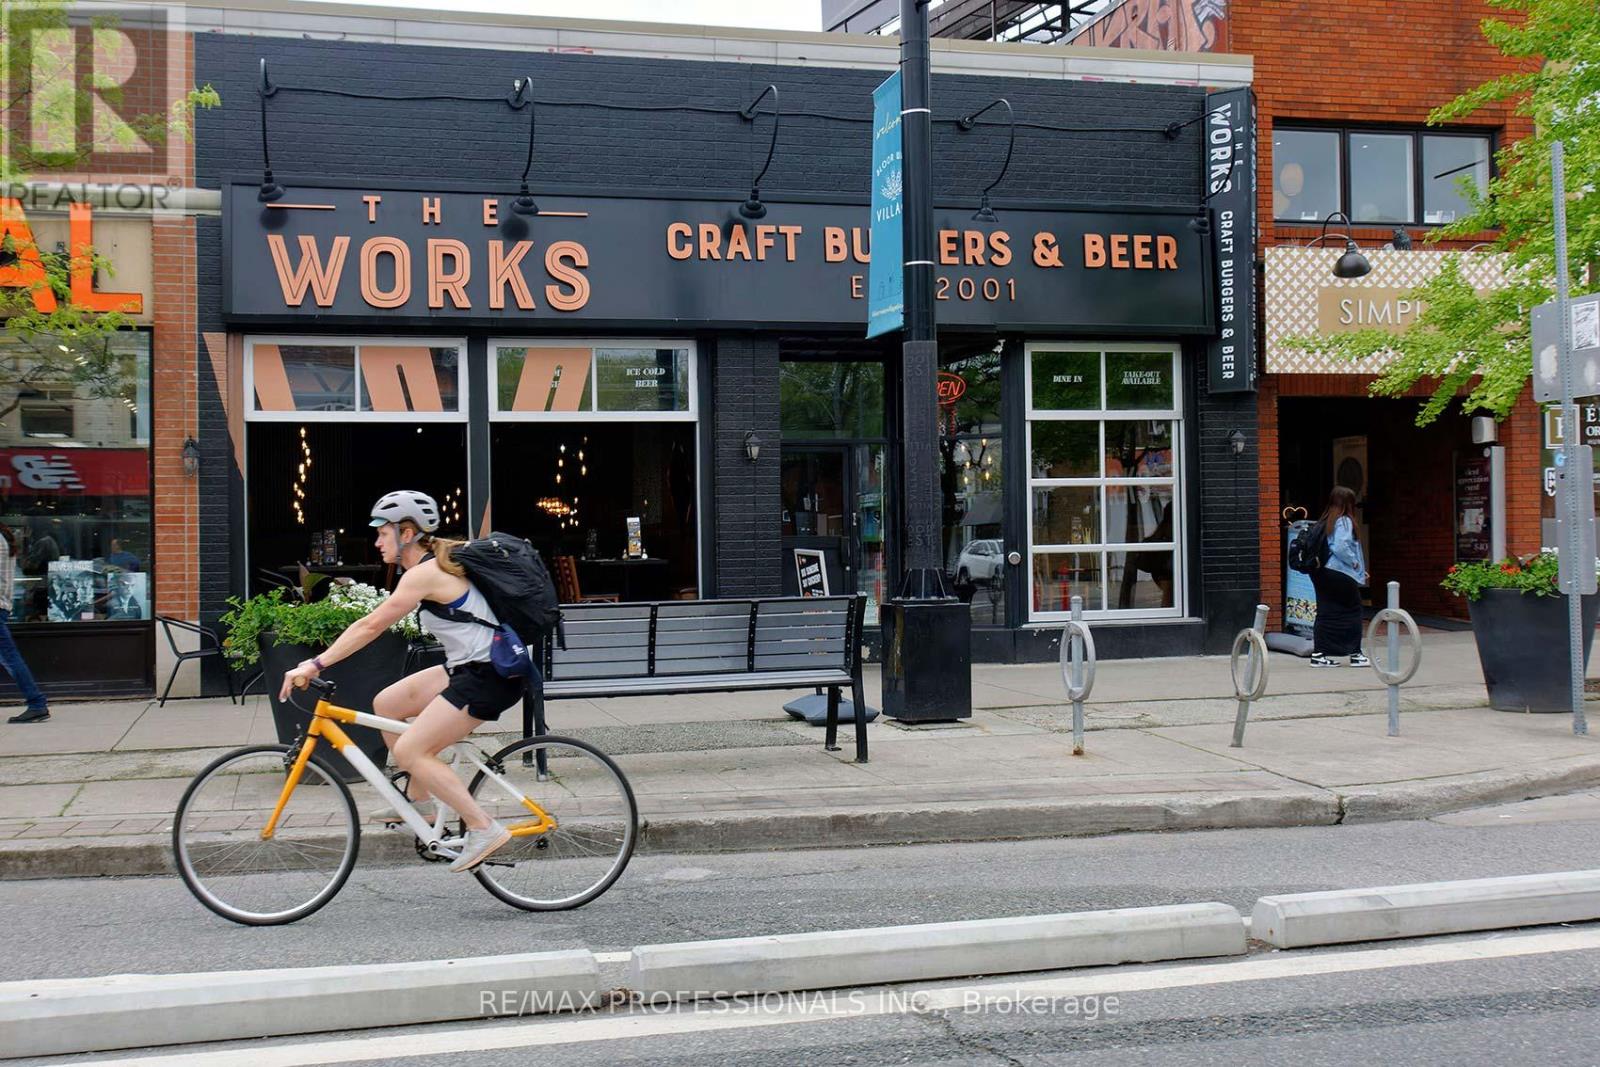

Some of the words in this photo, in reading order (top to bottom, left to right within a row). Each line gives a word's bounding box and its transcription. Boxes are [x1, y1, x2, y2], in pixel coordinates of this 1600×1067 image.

[1210, 103, 1232, 193] WORKS
[1235, 127, 1243, 166] THE
[363, 195, 498, 225] THE
[876, 202, 903, 222] VILLA
[1220, 210, 1233, 253] CRAFT
[666, 222, 802, 262] CRAFT
[824, 226, 1013, 267] BUERS
[1033, 231, 1064, 268] &
[1084, 233, 1178, 270] BEER
[266, 235, 591, 311] WORKS
[936, 277, 1016, 300] 2001
[1221, 260, 1234, 322] BURGERS
[1221, 328, 1234, 339] &
[626, 368, 641, 376] ICE
[643, 367, 666, 376] COLD
[1222, 345, 1235, 379] BEER
[635, 380, 658, 388] BEER
[1053, 375, 1072, 383] DINE
[1073, 375, 1083, 383] IN
[1121, 377, 1161, 385] AVAILABLE
[1123, 370, 1161, 378] TAKE-OUT
[937, 381, 961, 397] EN
